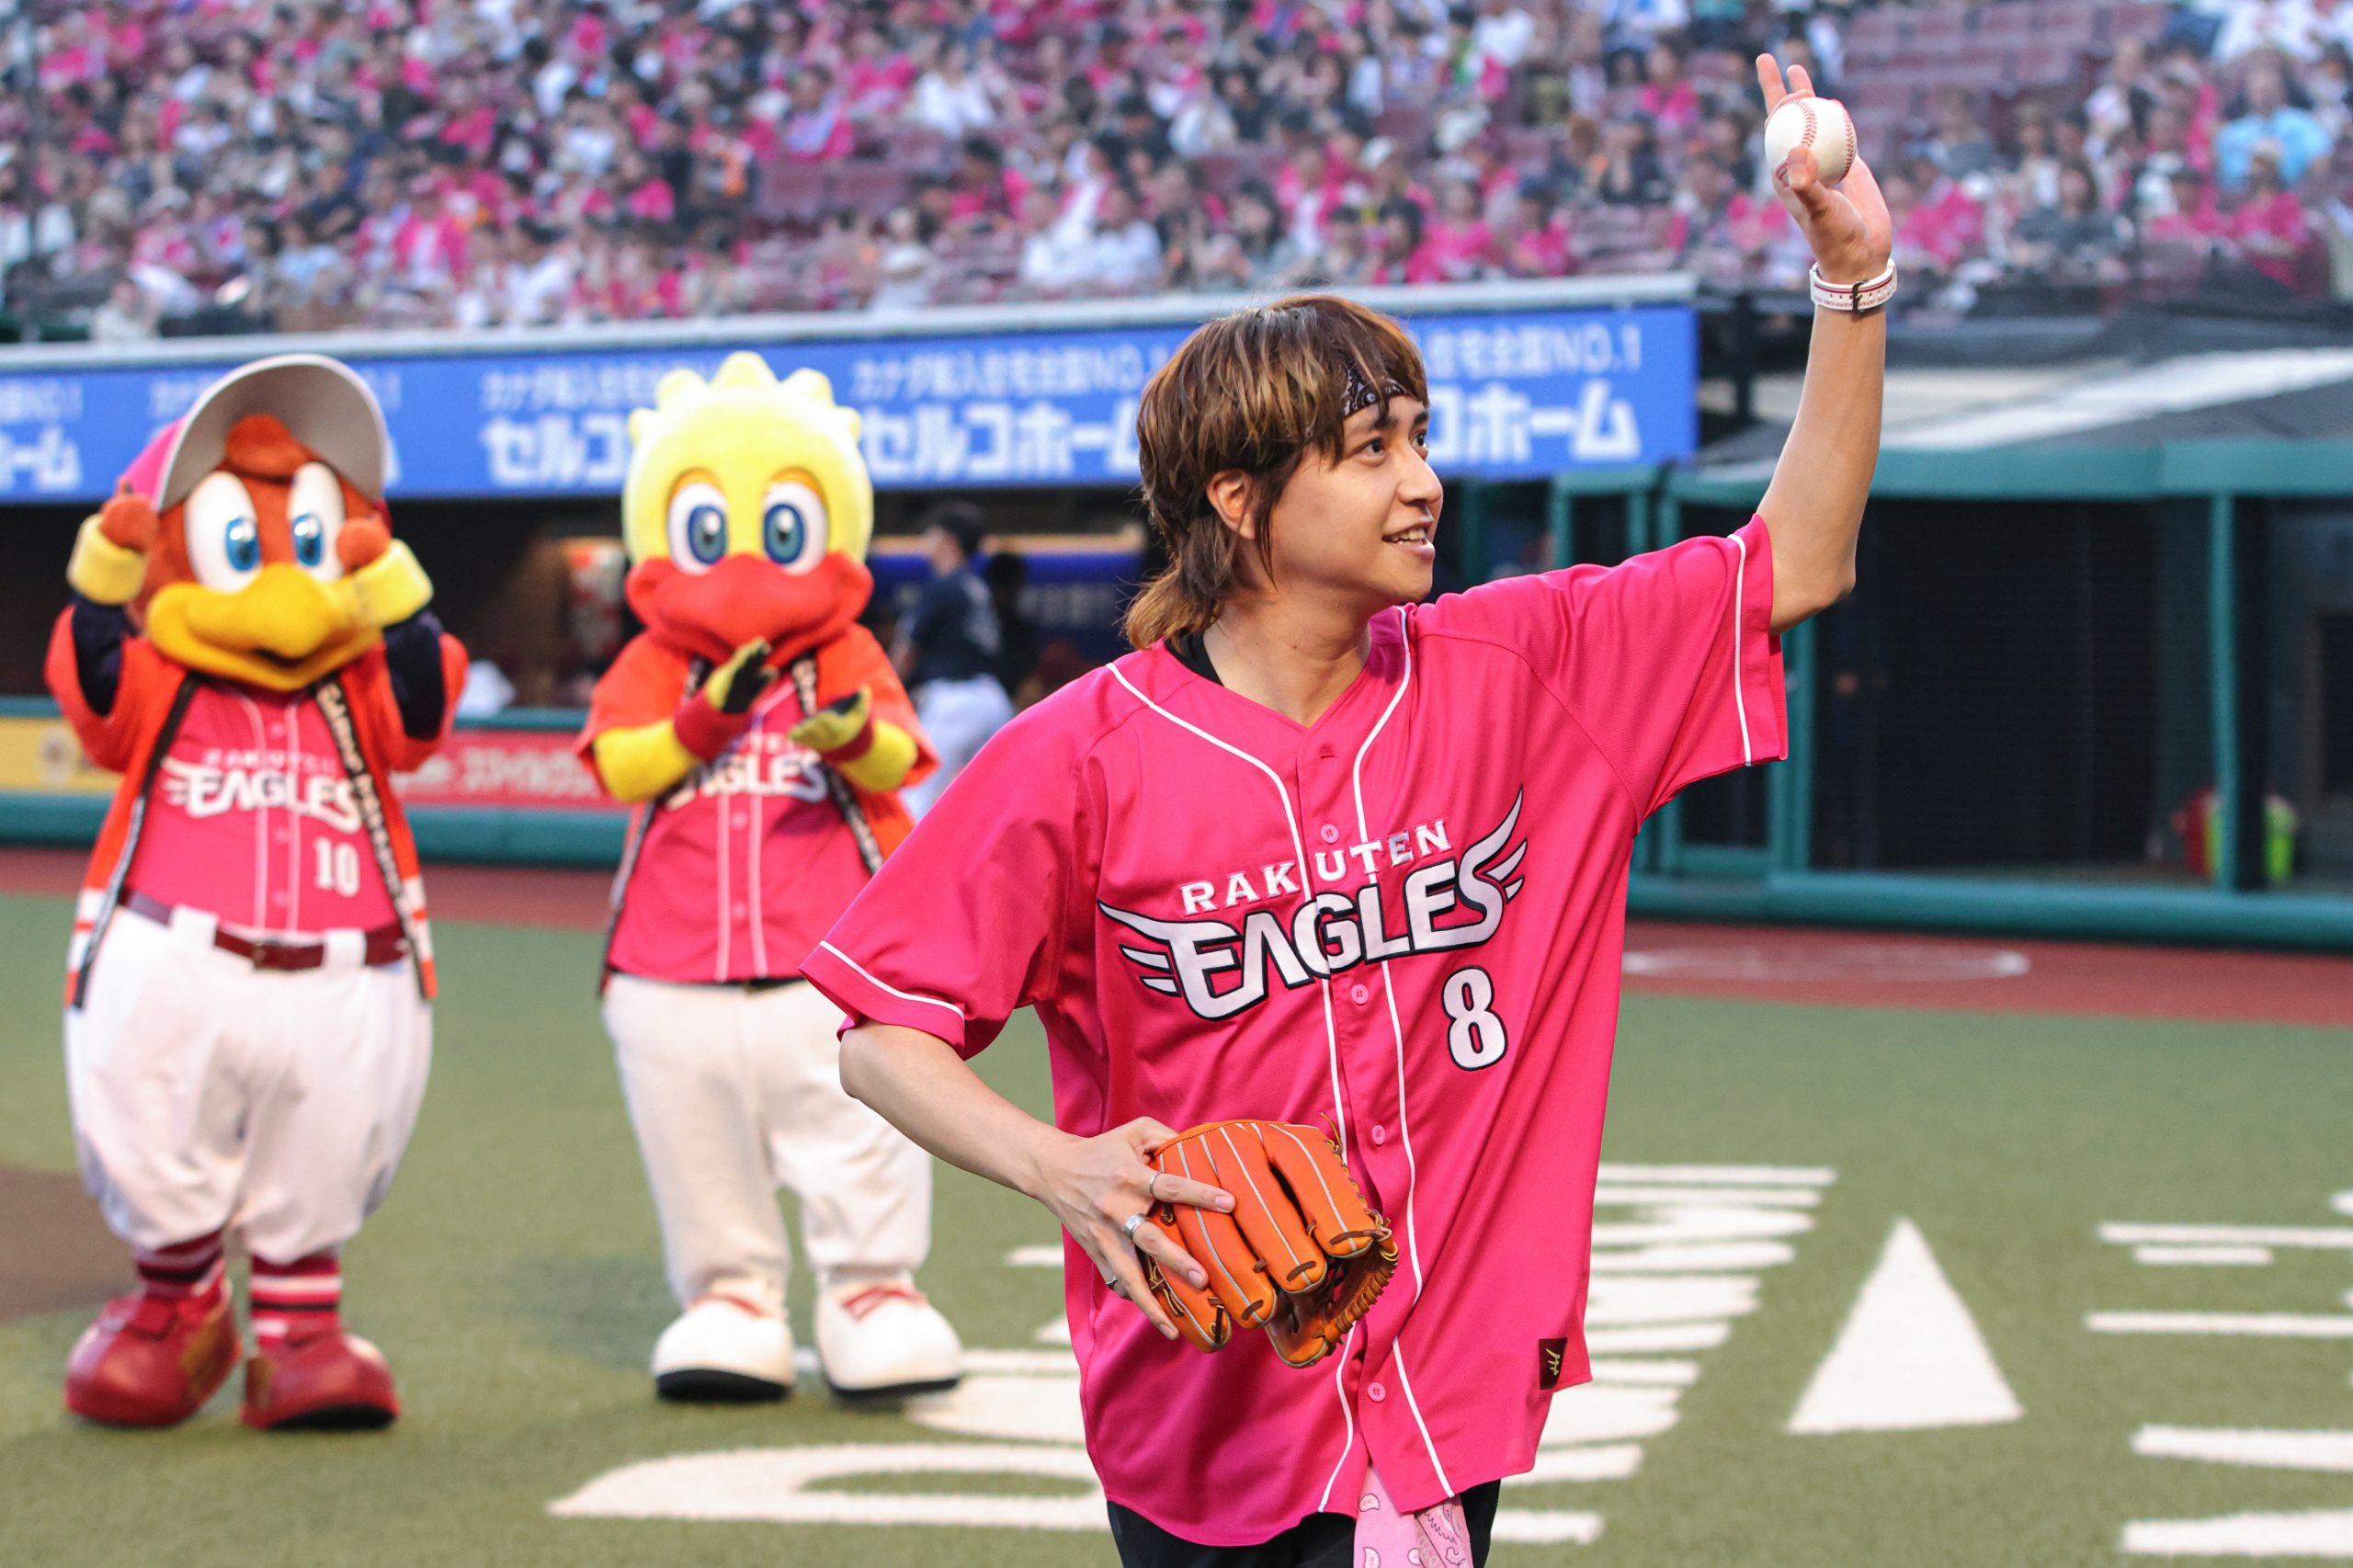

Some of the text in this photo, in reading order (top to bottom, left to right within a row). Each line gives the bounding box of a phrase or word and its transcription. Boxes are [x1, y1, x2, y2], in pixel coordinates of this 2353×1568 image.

[1824, 299, 1853, 308] HAMPIONS
[1421, 323, 1643, 379] 住宅全国NO.1
[161, 756, 363, 835] EAGLES
[314, 838, 360, 898] 10
[1097, 786, 1528, 1021] EAGLES
[1178, 819, 1453, 916] RAKUTEN
[1441, 966, 1508, 1072] 8
